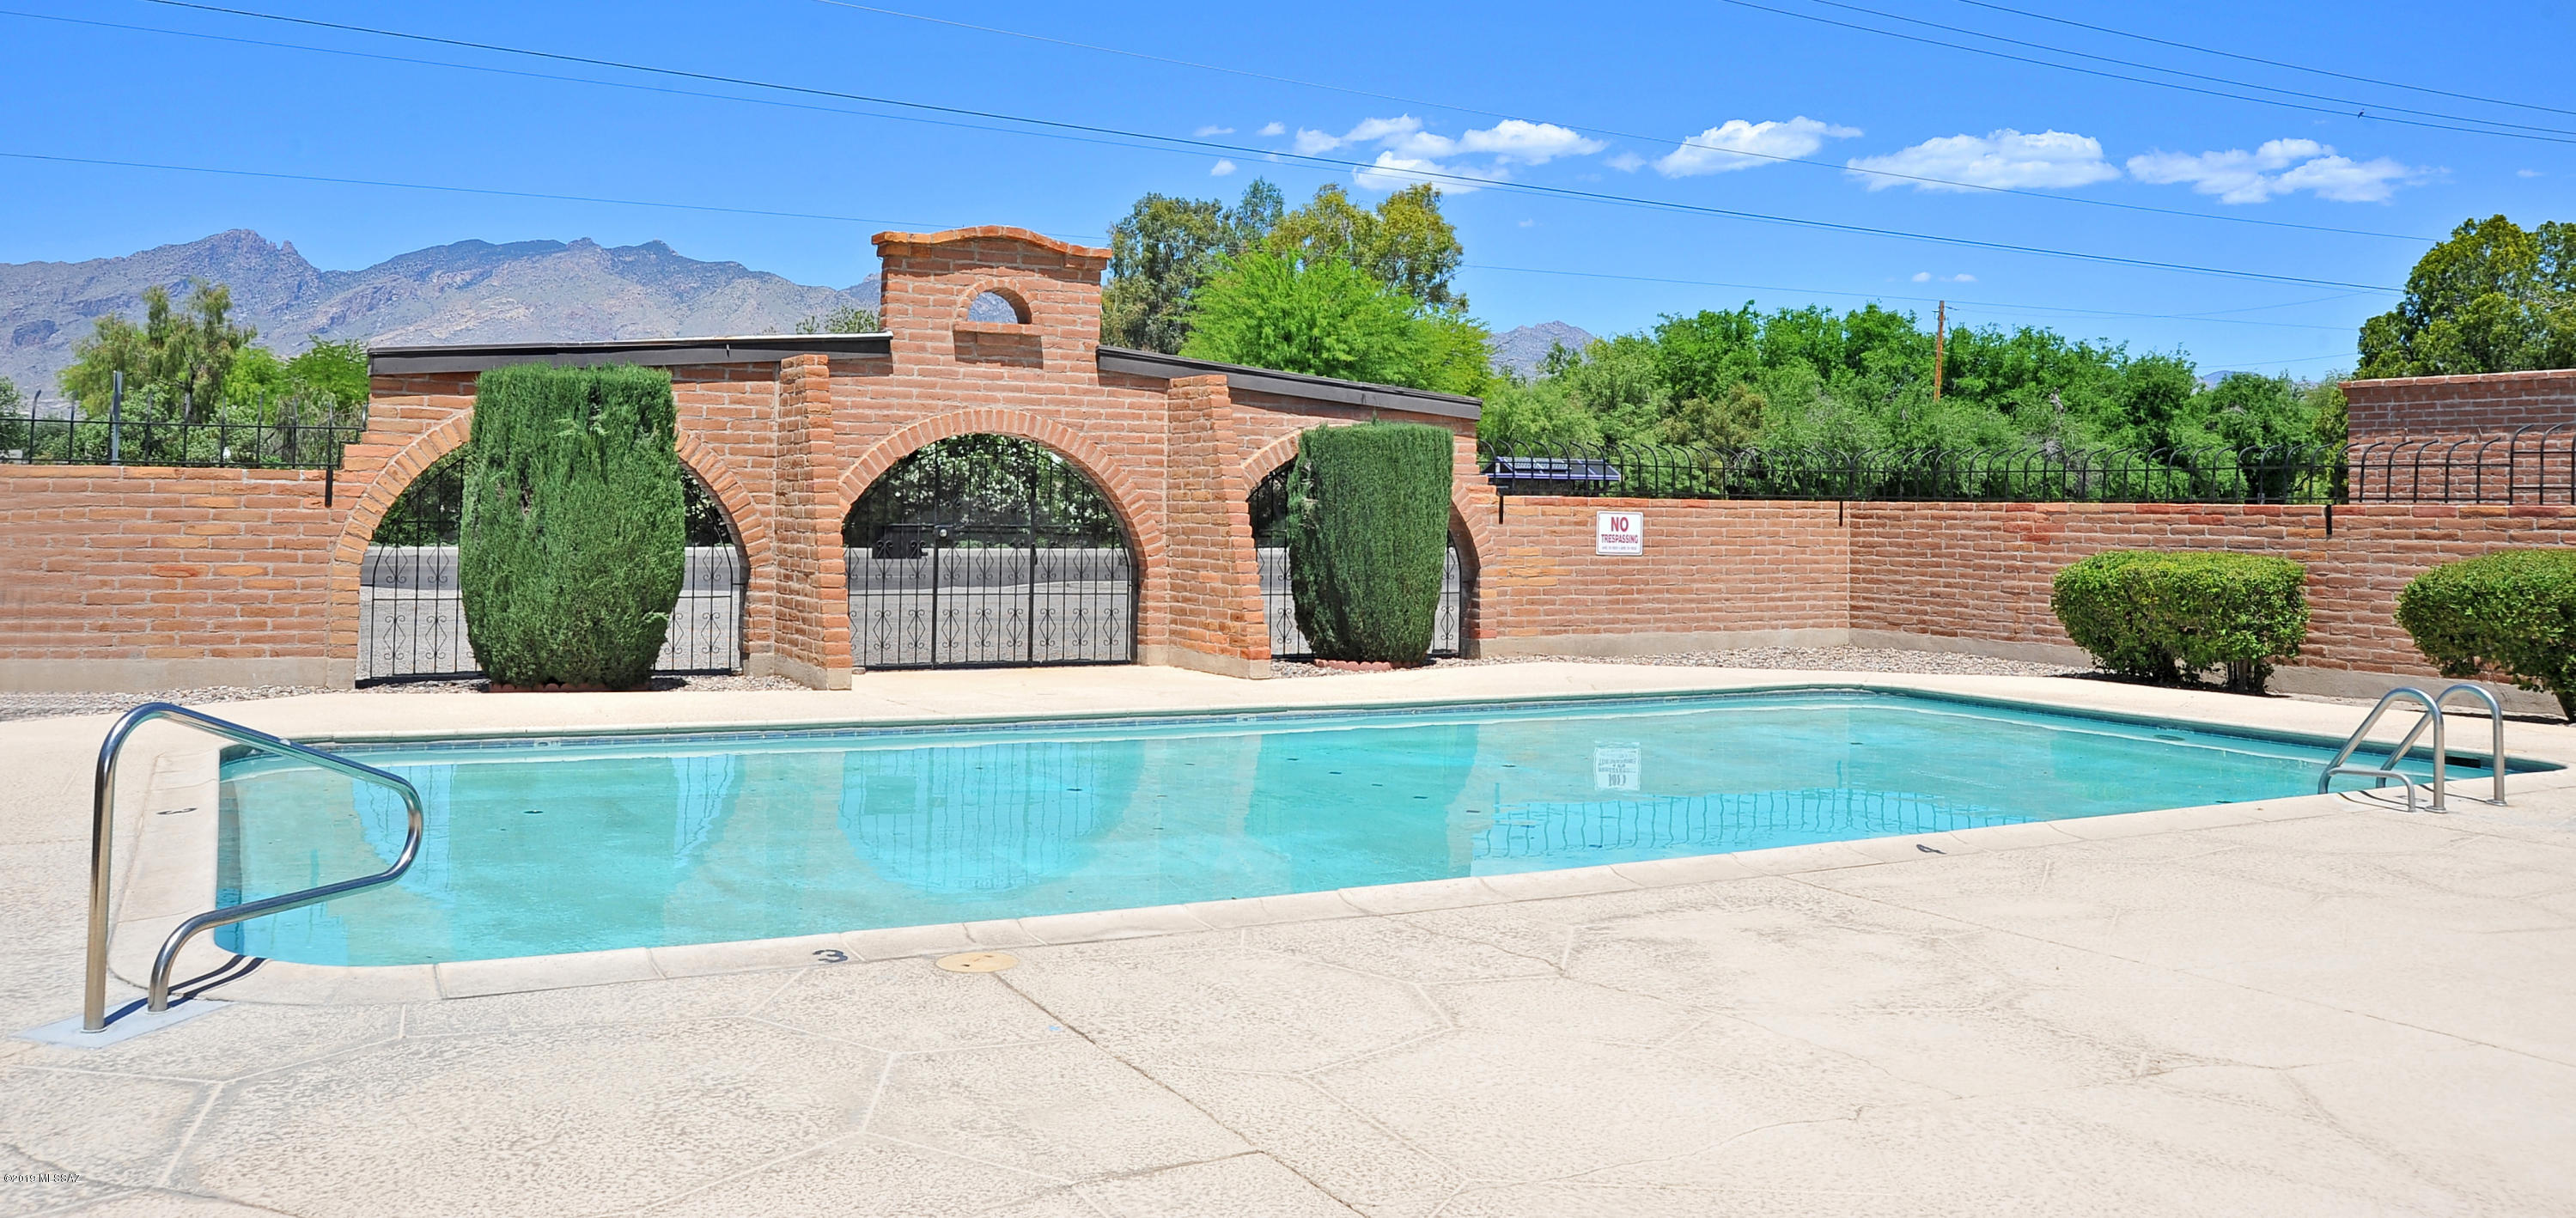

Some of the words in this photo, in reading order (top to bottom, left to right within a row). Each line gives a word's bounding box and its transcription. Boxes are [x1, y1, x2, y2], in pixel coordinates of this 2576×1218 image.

[1611, 516, 1629, 533] NO
[1601, 533, 1638, 544] TRESPASSING
[812, 948, 849, 963] 3
